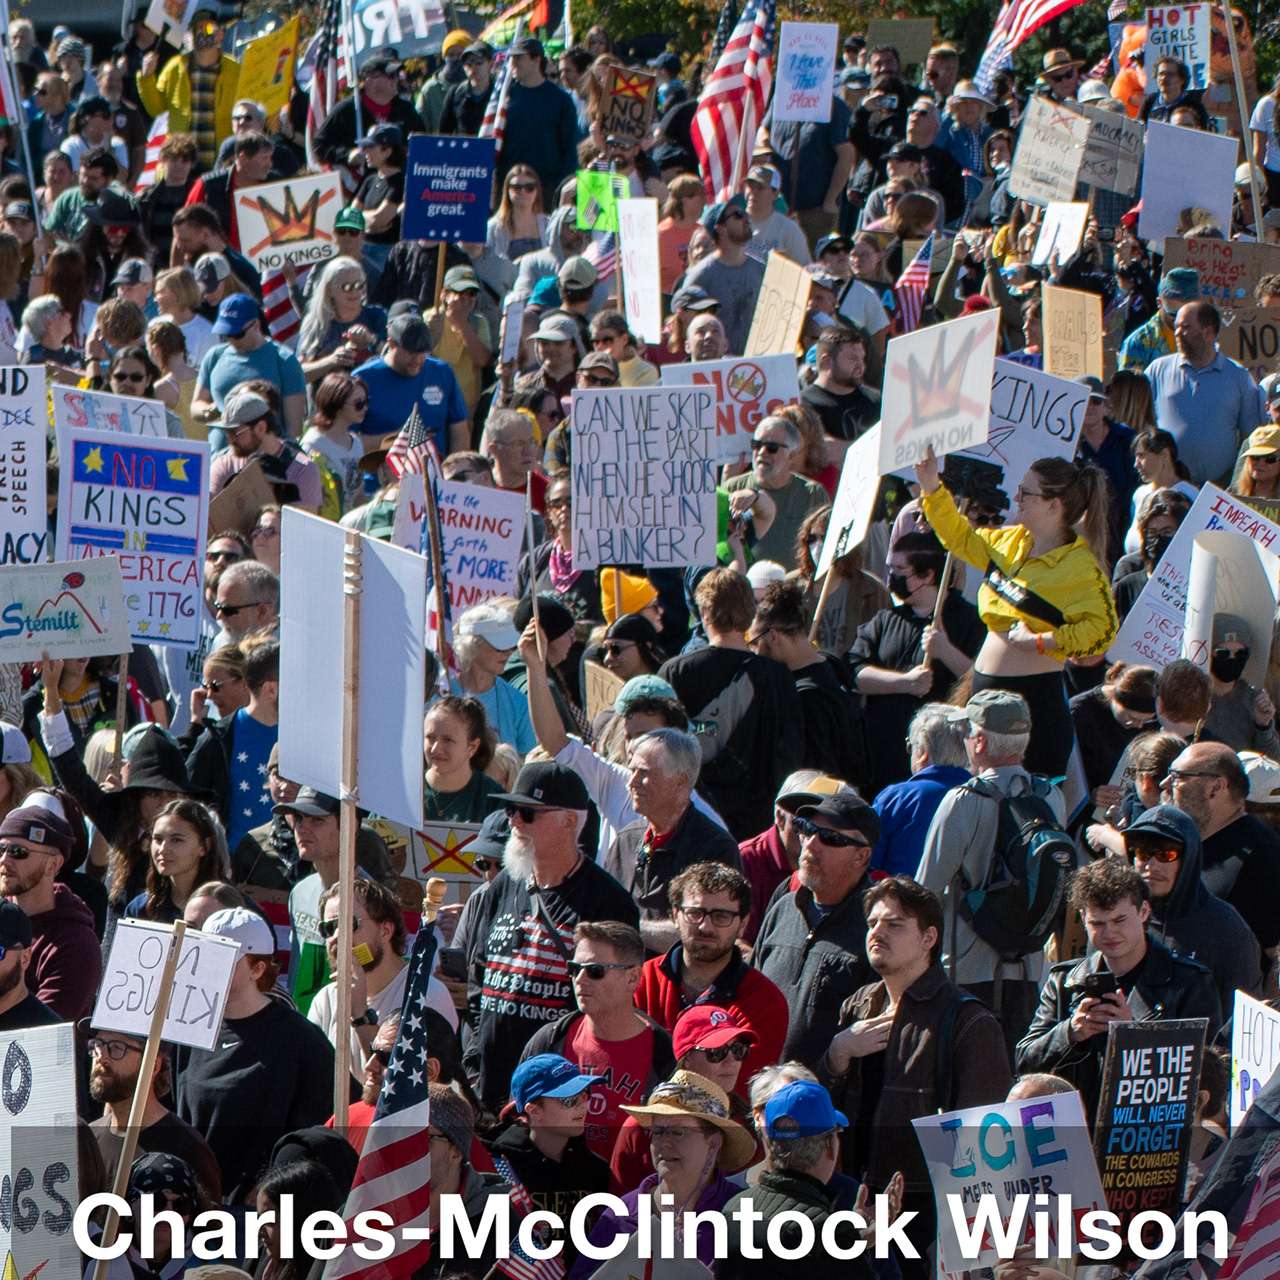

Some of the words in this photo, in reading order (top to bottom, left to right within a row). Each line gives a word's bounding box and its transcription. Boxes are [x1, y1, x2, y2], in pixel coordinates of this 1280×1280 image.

[1147, 6, 1202, 28] HOT
[1150, 29, 1196, 43] GIRLS
[611, 100, 645, 118] NO
[413, 162, 487, 181] Immigrants
[421, 188, 476, 202] America
[431, 178, 467, 191] make
[427, 202, 465, 218] great.
[257, 254, 283, 270] NO
[283, 245, 333, 267] KINGS
[573, 393, 624, 436] CAN
[632, 395, 662, 430] WE
[667, 393, 710, 433] SKIP
[576, 430, 601, 463] TO
[611, 427, 655, 462] THE
[663, 427, 710, 463] PART
[12, 439, 28, 516] SPEECH
[112, 450, 156, 491] NO
[82, 485, 187, 529] KINGS
[576, 497, 673, 531] HIMSELF
[675, 497, 703, 527] IN
[1208, 495, 1279, 549] IMPEACH
[500, 995, 517, 1014] NO
[519, 1003, 569, 1020] KINGS
[1121, 1048, 1153, 1077] WE
[1156, 1045, 1194, 1076] THE
[1116, 1073, 1190, 1106] PEOPLE
[1112, 1105, 1144, 1124] WILL
[1147, 1102, 1186, 1122] NEVER
[940, 1101, 1069, 1178] ICE
[1106, 1122, 1183, 1153] FORGET
[1104, 1153, 1125, 1171] THE
[1126, 1151, 1180, 1169] COWARDS
[1102, 1171, 1116, 1189] IN
[1116, 1168, 1179, 1187] CONGRESS
